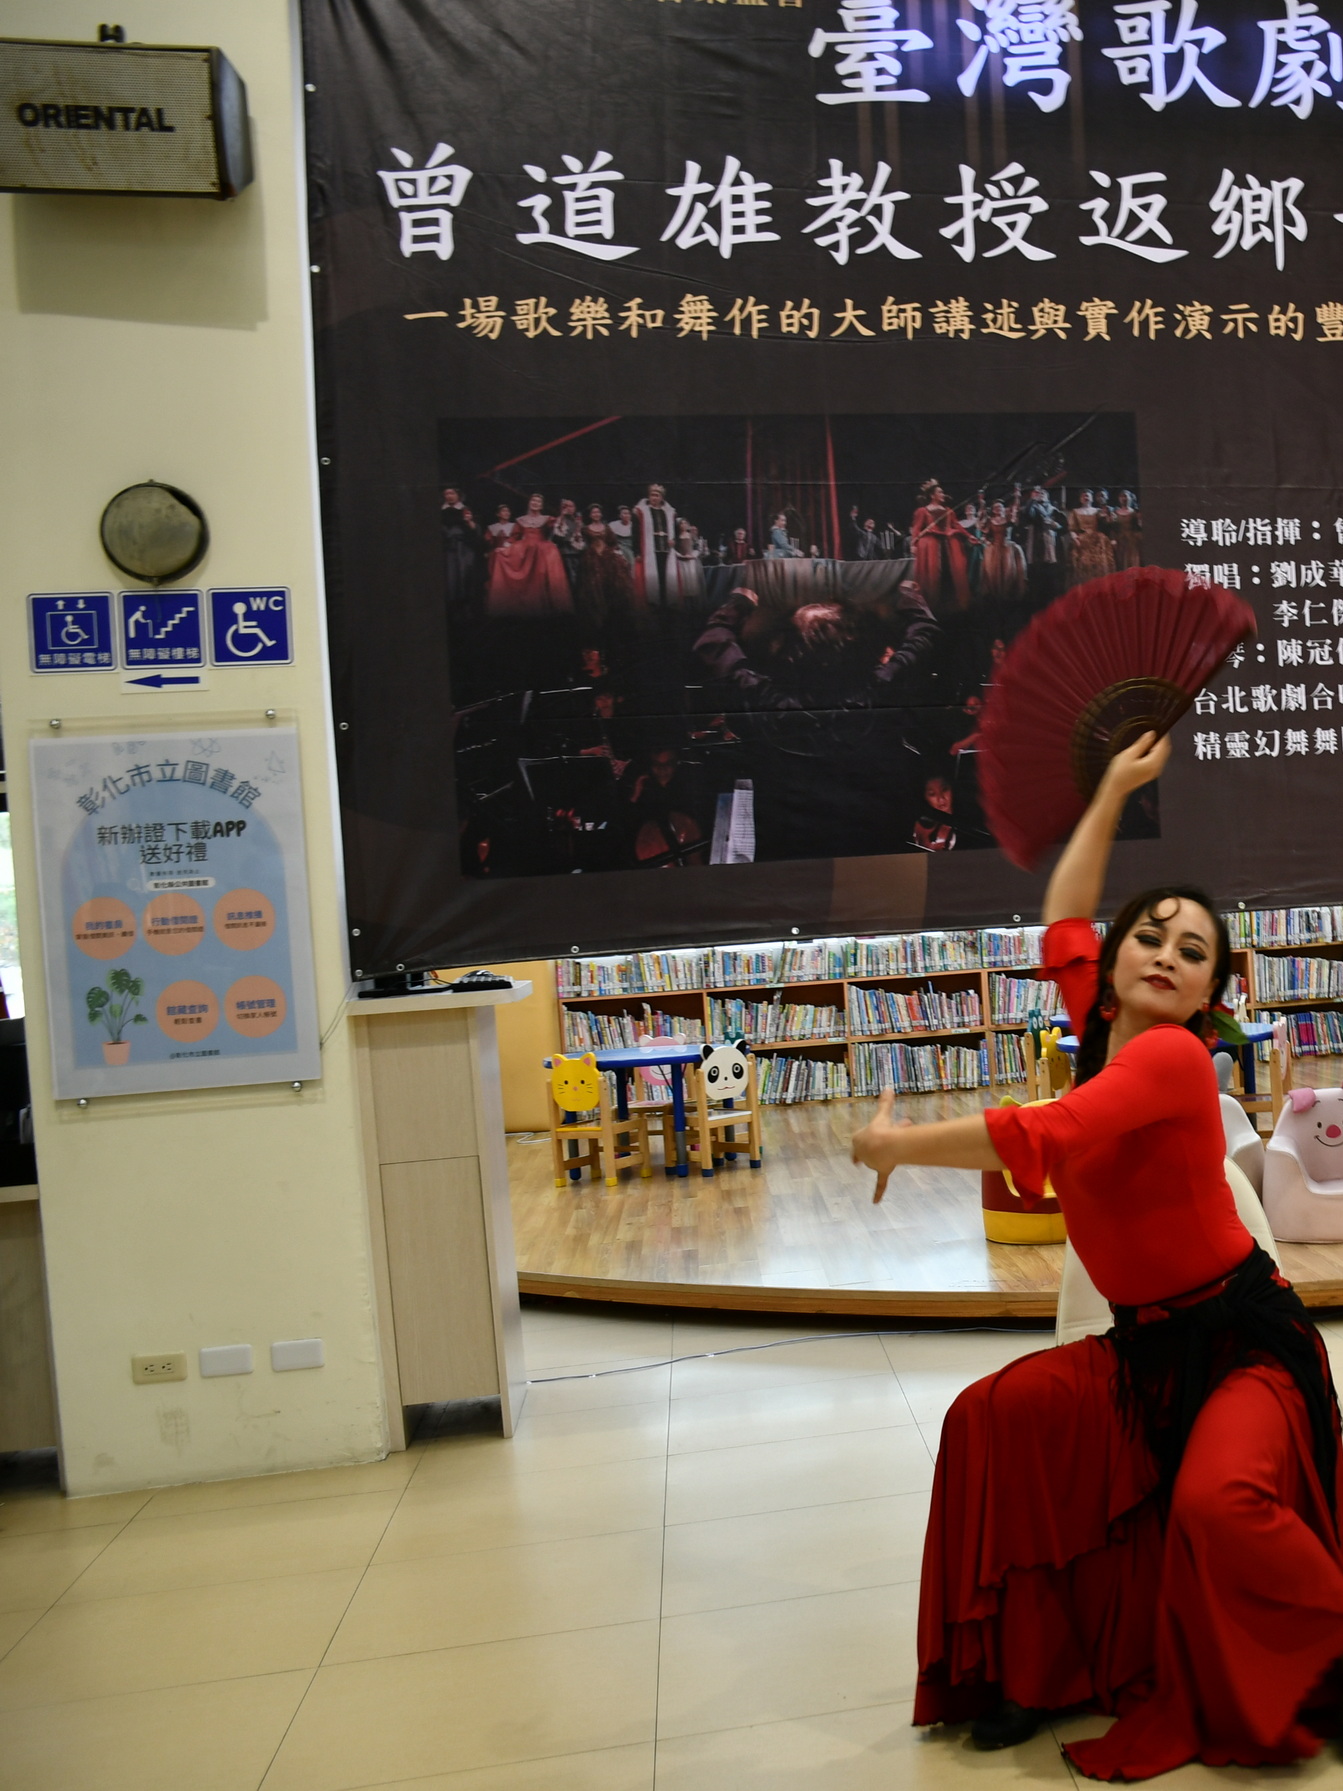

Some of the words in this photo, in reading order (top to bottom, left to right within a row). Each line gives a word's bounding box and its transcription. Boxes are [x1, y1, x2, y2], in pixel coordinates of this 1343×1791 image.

[17, 102, 176, 133] ORIENTAL
[249, 596, 284, 612] WC
[38, 651, 112, 666] 無障礙電梯
[128, 647, 200, 661] 無障礙樓梯
[75, 758, 262, 817] 彰化市立圖書館
[96, 819, 248, 847] 新辦證下載APP
[139, 842, 208, 866] 送好禮
